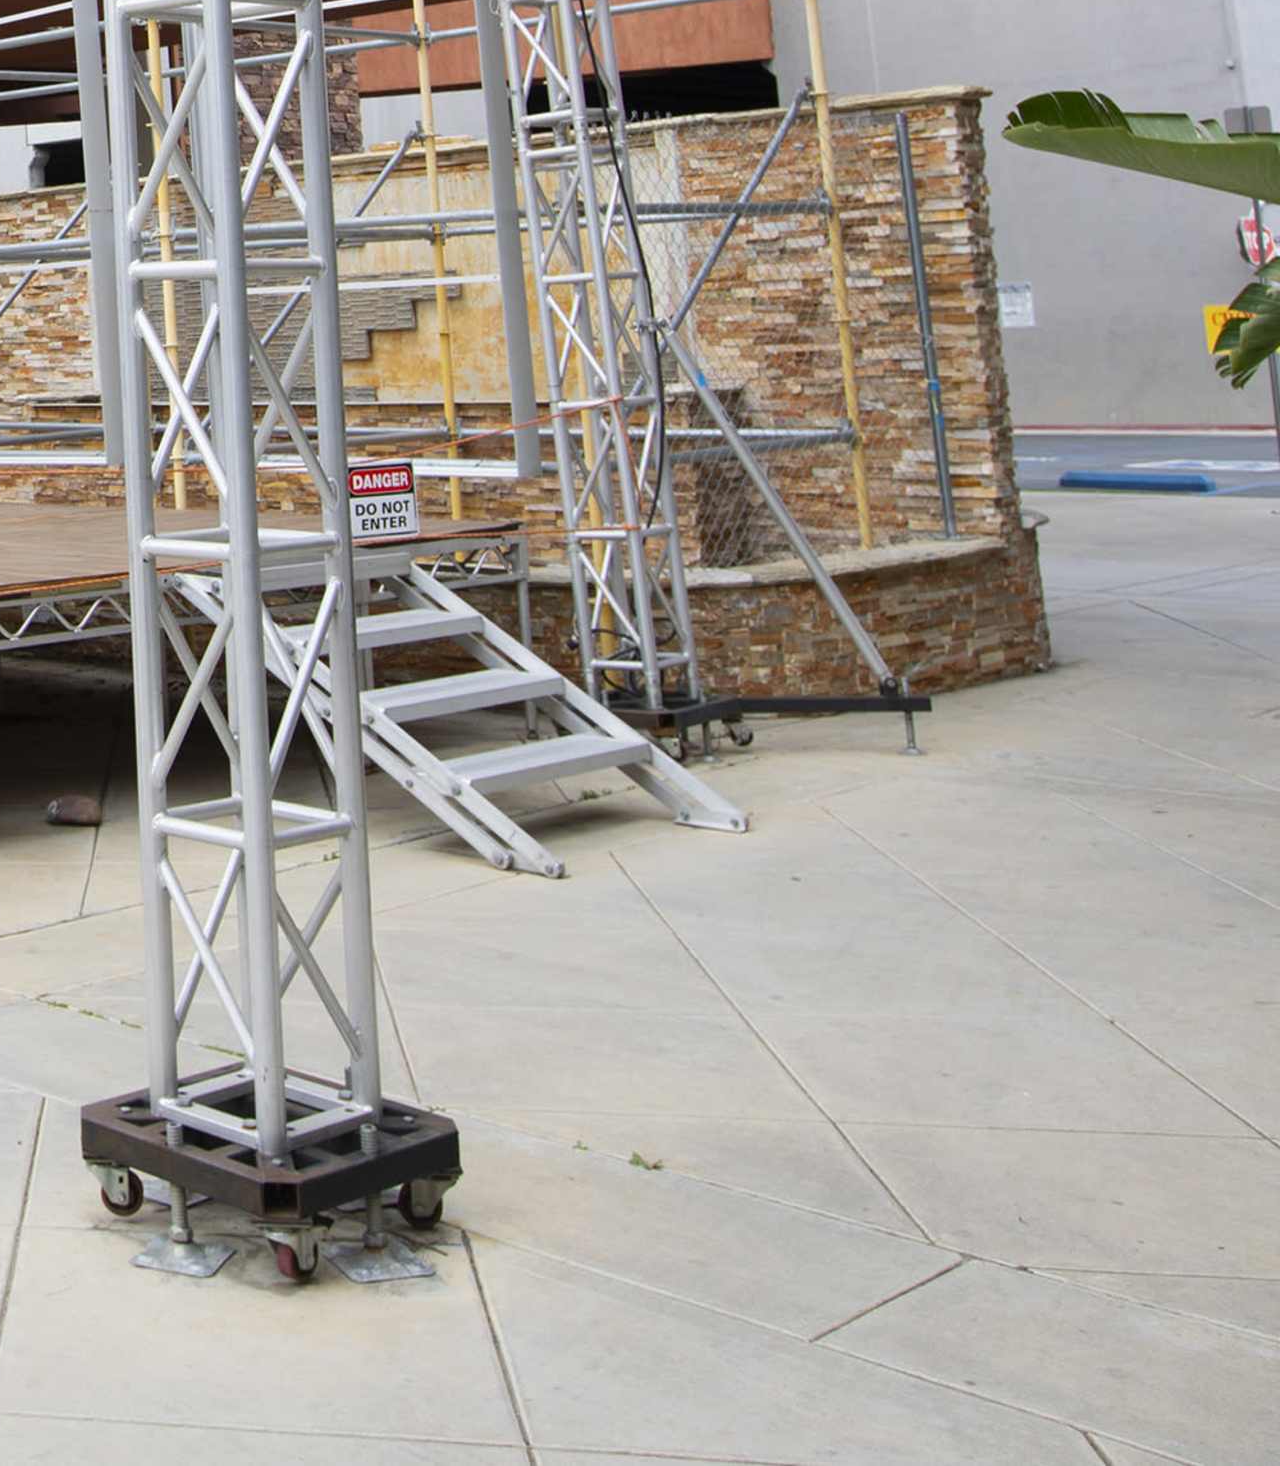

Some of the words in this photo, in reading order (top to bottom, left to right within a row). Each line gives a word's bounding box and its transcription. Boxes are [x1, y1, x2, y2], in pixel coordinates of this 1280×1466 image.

[352, 471, 409, 491] DANGER
[355, 502, 377, 517] DO
[382, 500, 410, 514] NOT
[361, 515, 407, 532] ENTER
